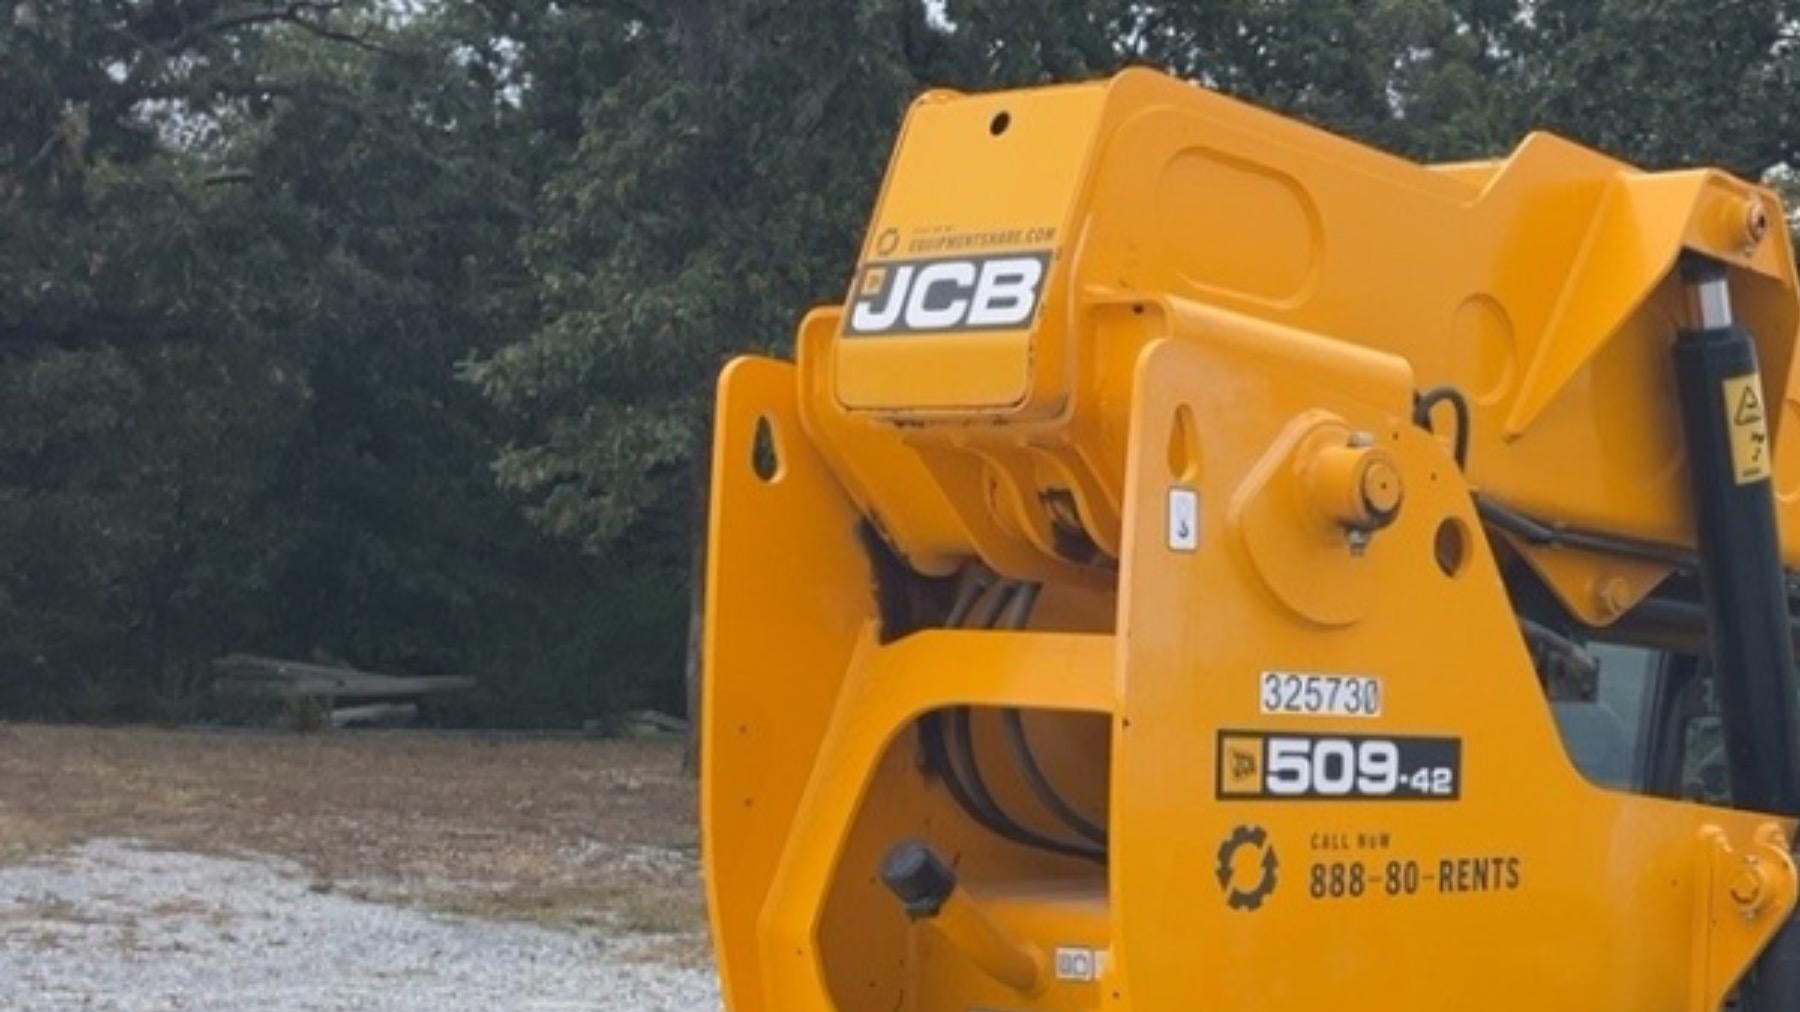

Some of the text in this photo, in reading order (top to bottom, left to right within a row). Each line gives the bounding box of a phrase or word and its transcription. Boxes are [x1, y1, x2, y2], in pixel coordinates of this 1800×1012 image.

[851, 256, 1042, 331] JCB
[1264, 673, 1378, 715] 325730
[1310, 832, 1349, 850] CALL
[1309, 857, 1520, 899] 888-80-RENTS
